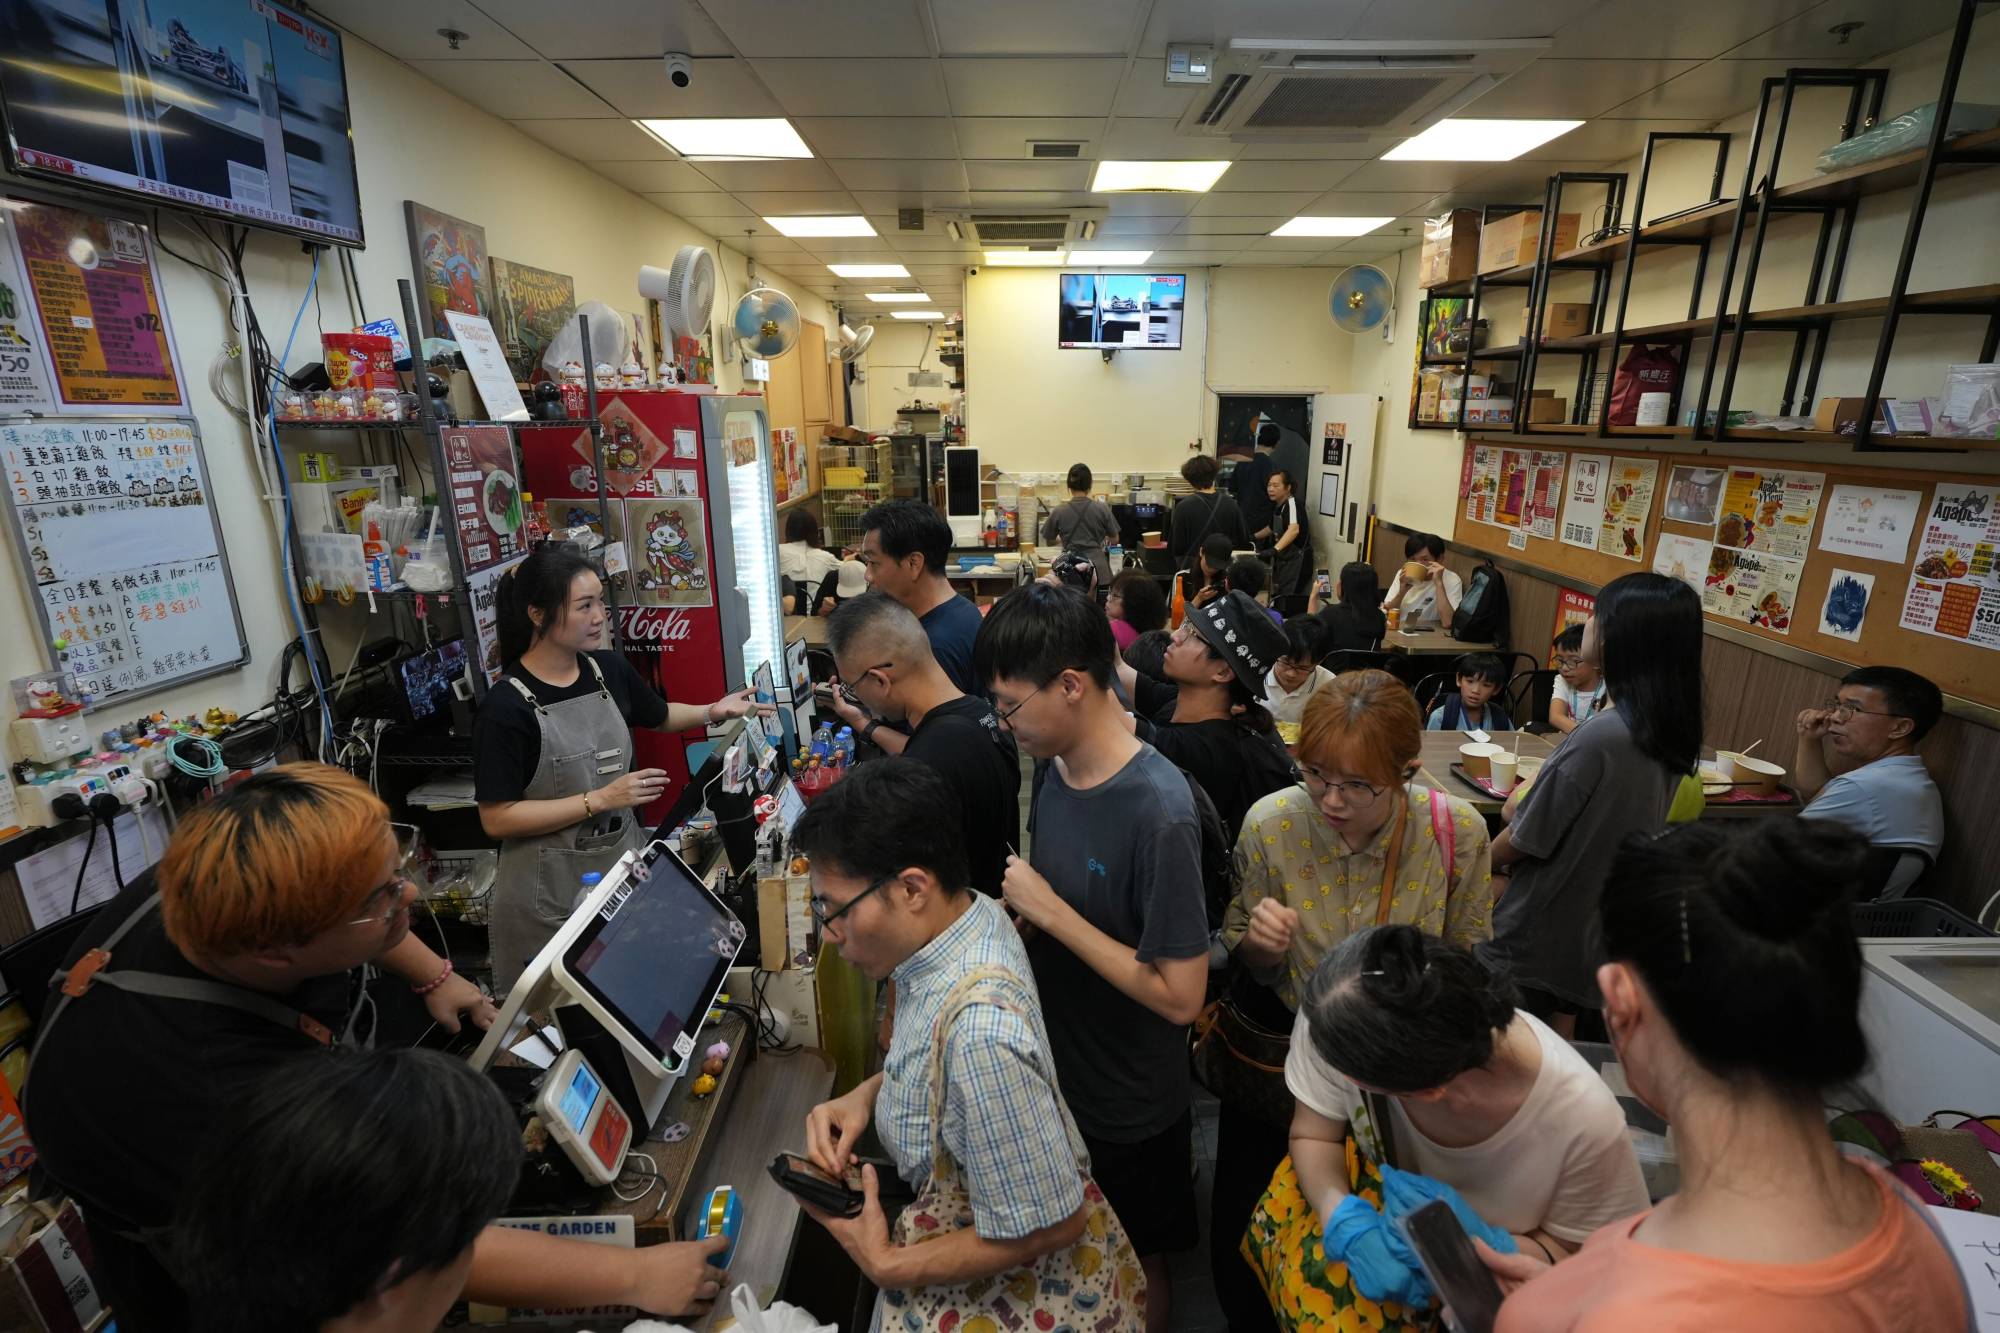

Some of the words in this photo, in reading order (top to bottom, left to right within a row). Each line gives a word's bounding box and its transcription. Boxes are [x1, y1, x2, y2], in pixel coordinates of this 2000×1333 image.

[510, 277, 570, 312] SPIDER-MAN
[0, 354, 30, 373] 50
[32, 466, 112, 484] 白切雞飯
[644, 645, 675, 653] TASTE
[601, 893, 622, 919] THANK
[547, 1222, 616, 1236] GARDEN
